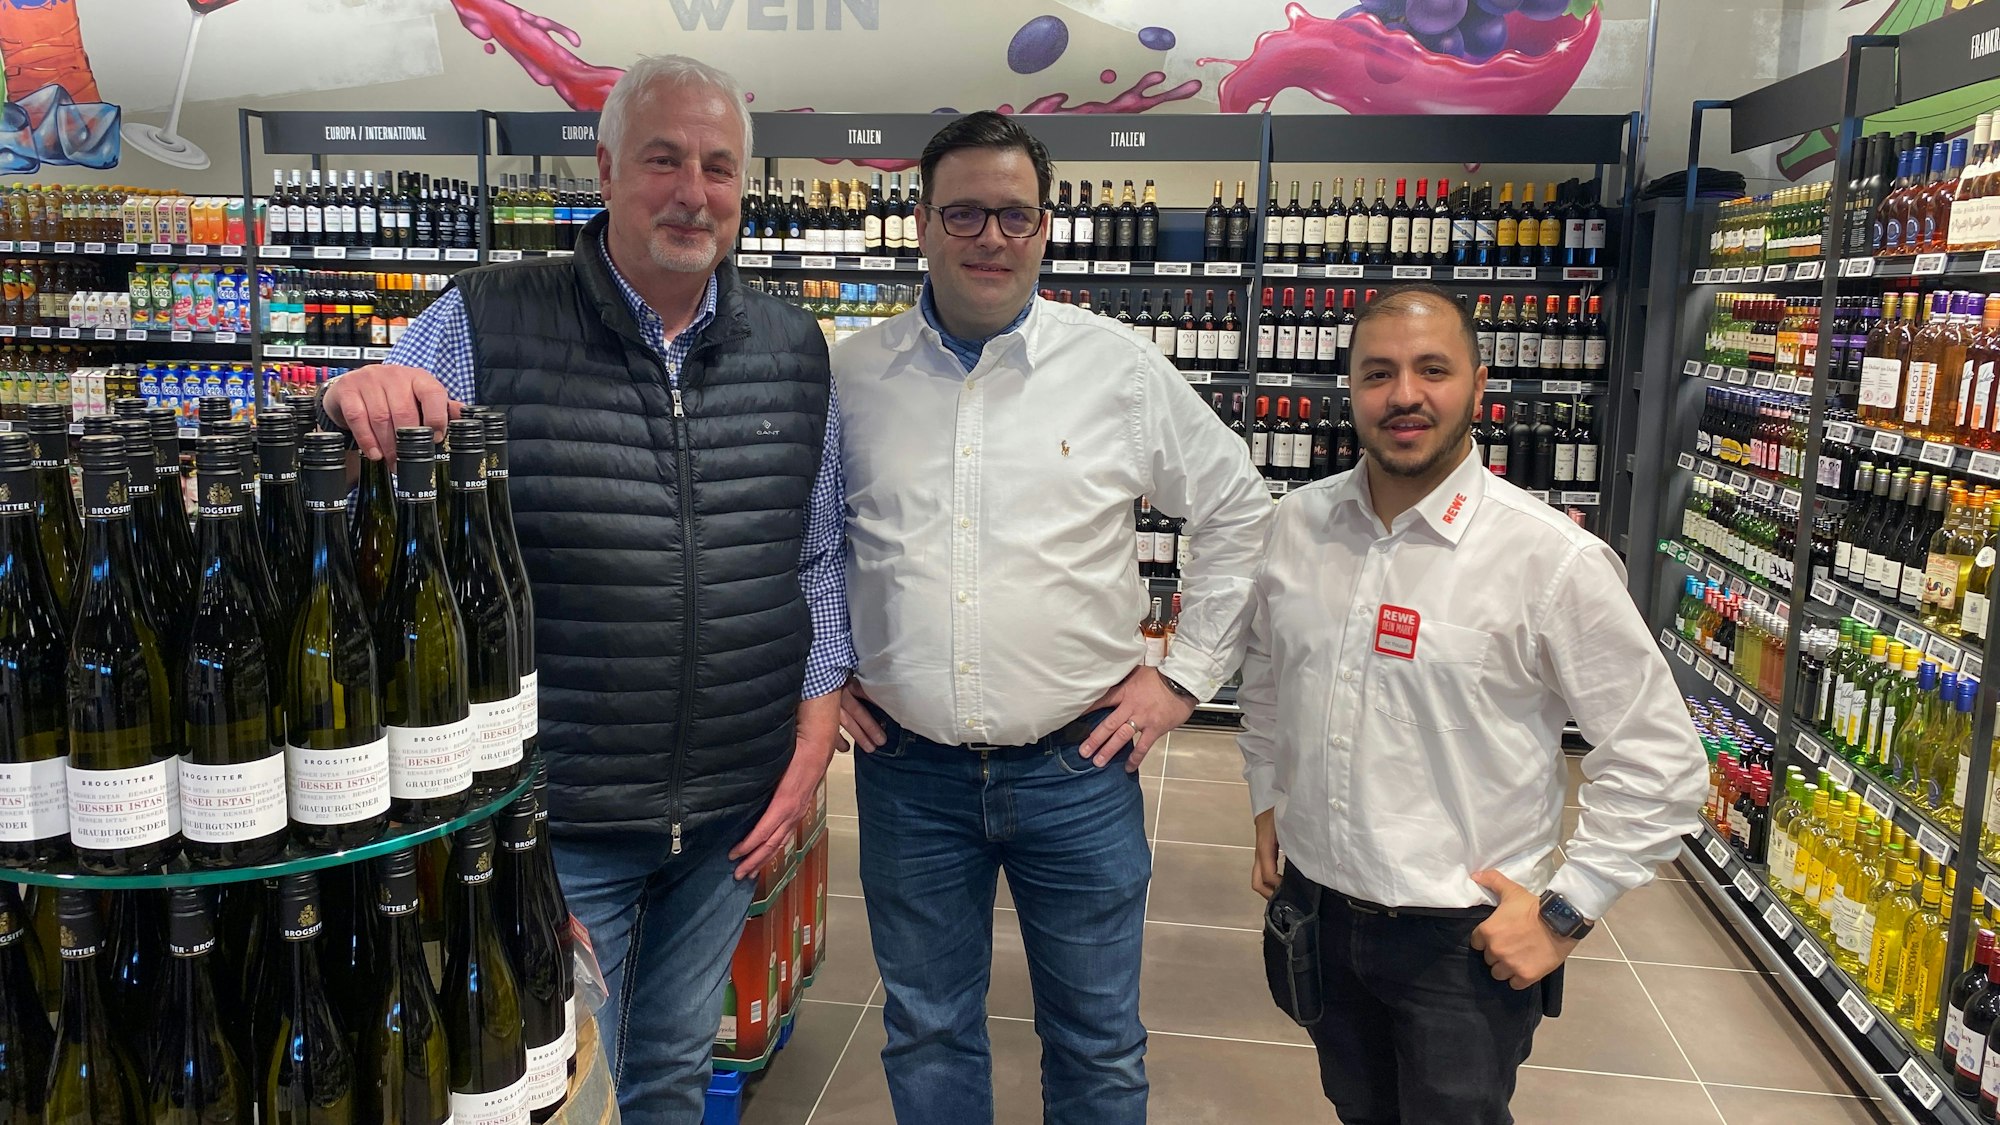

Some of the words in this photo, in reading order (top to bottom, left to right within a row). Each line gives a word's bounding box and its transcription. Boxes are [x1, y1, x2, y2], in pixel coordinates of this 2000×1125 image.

[669, 0, 879, 31] WEIN
[1971, 26, 2000, 60] FRANKR
[325, 126, 356, 141] EUROPA
[358, 126, 363, 141] /
[365, 126, 426, 141] INTERNATIONAL
[562, 126, 595, 141] EUROPA
[848, 129, 881, 145] ITALIEN
[1110, 131, 1146, 148] ITALIEN
[1909, 369, 1920, 413] MERLOT
[1924, 370, 1934, 416] MERLOT
[1442, 492, 1467, 525] REWE
[1383, 609, 1416, 626] REWE
[1381, 619, 1396, 632] DEIN
[1395, 622, 1414, 637] MARKT
[484, 725, 517, 740] BESSER
[304, 754, 369, 766] BROGSITTER
[408, 756, 450, 767] BESSER
[82, 774, 155, 787] BROGSITTER
[300, 780, 342, 790] BESSER
[347, 774, 376, 788] ISTAS
[78, 804, 124, 814] BESSER
[129, 798, 163, 811] ISTAS
[217, 796, 252, 807] ISTAS
[299, 797, 379, 813] GRAUBURGUNDER
[77, 819, 167, 837] GRAUBURGUNDER
[1874, 937, 1886, 984] CHARDONNAY
